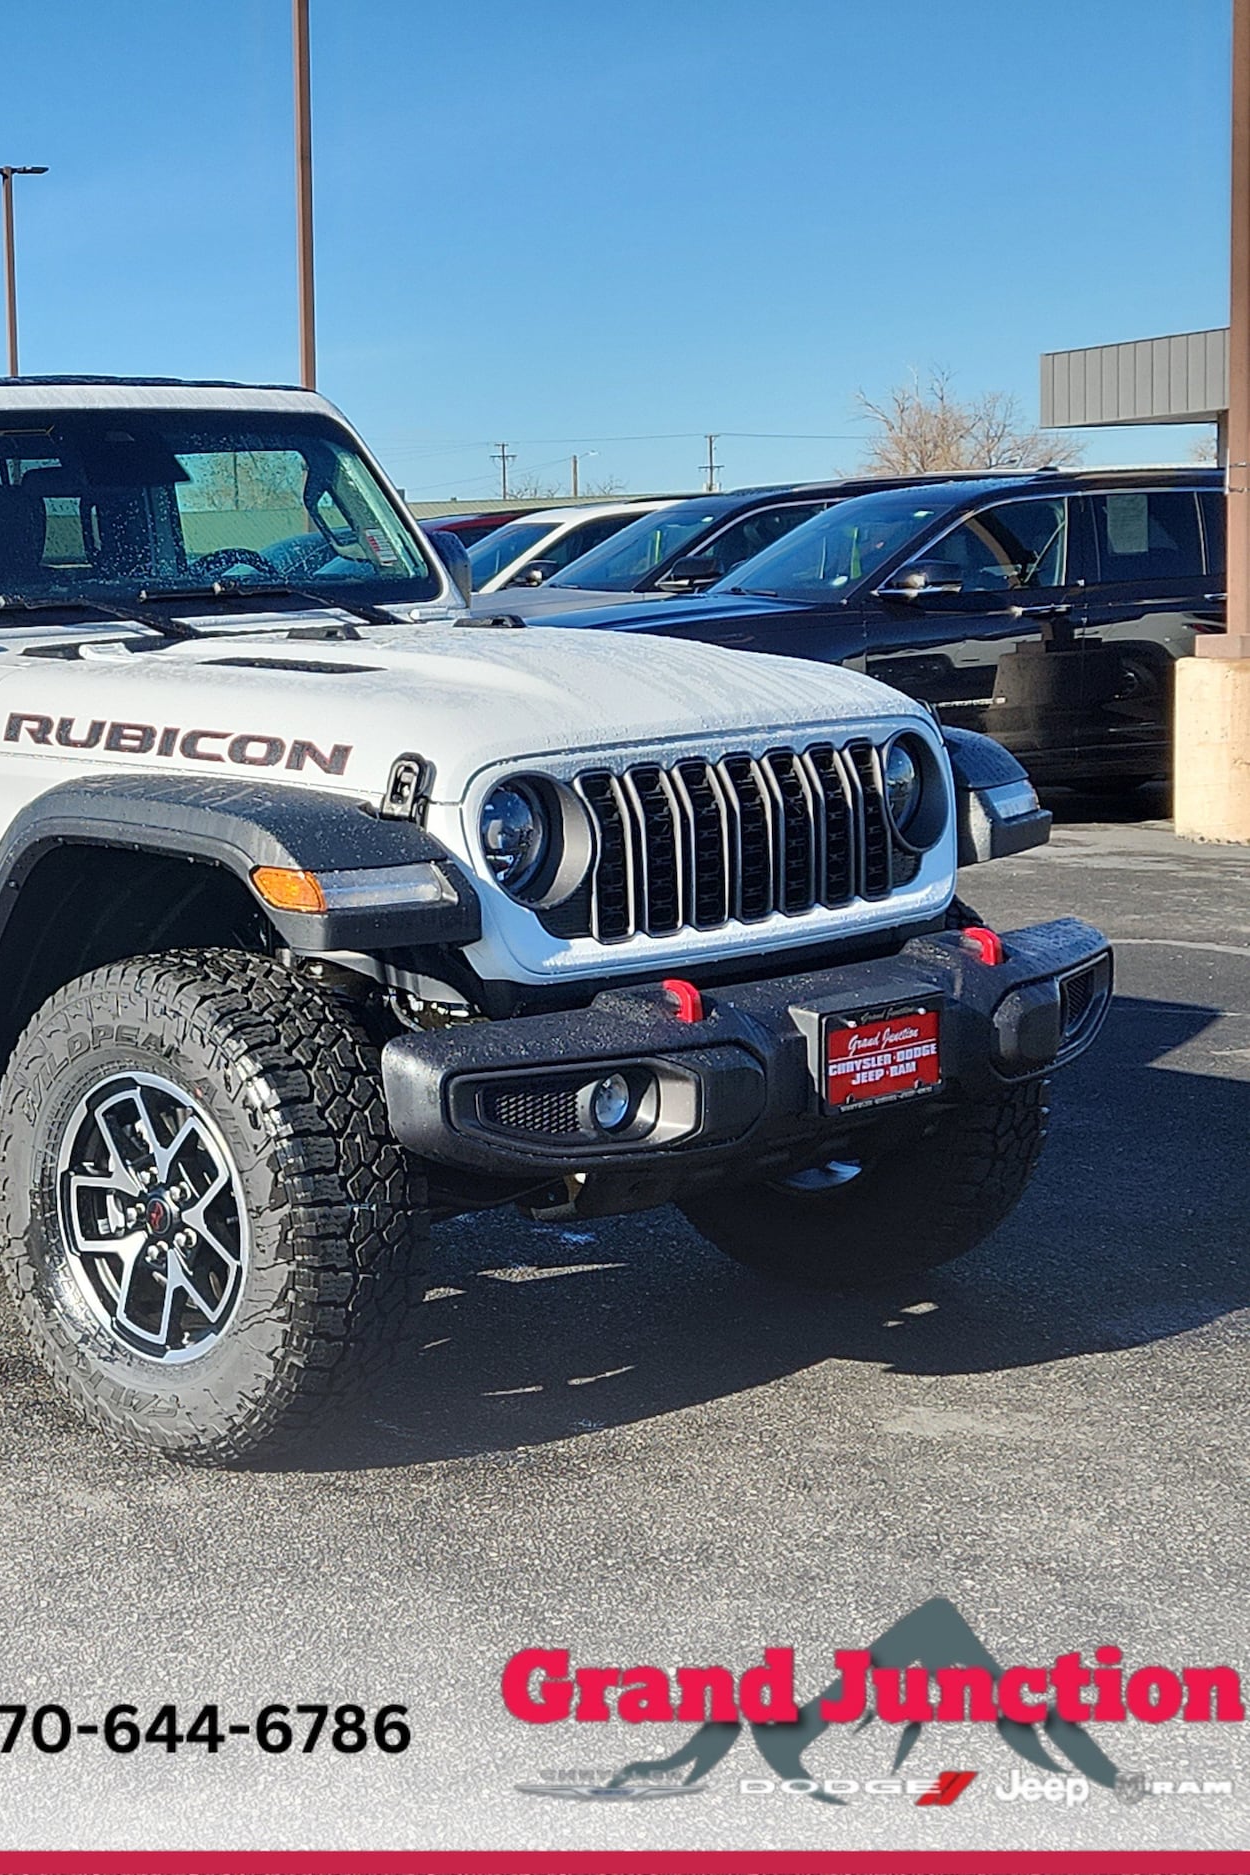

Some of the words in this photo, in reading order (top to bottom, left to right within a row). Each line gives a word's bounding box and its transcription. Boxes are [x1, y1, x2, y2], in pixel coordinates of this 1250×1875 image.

[3, 712, 354, 775] RUBICON
[848, 1032, 881, 1057] Grand
[881, 1027, 919, 1050] Junction
[828, 1053, 891, 1076] CHRYSLER
[896, 1043, 937, 1062] DODGE
[851, 1068, 884, 1085] JEEP
[890, 1061, 916, 1077] RAM
